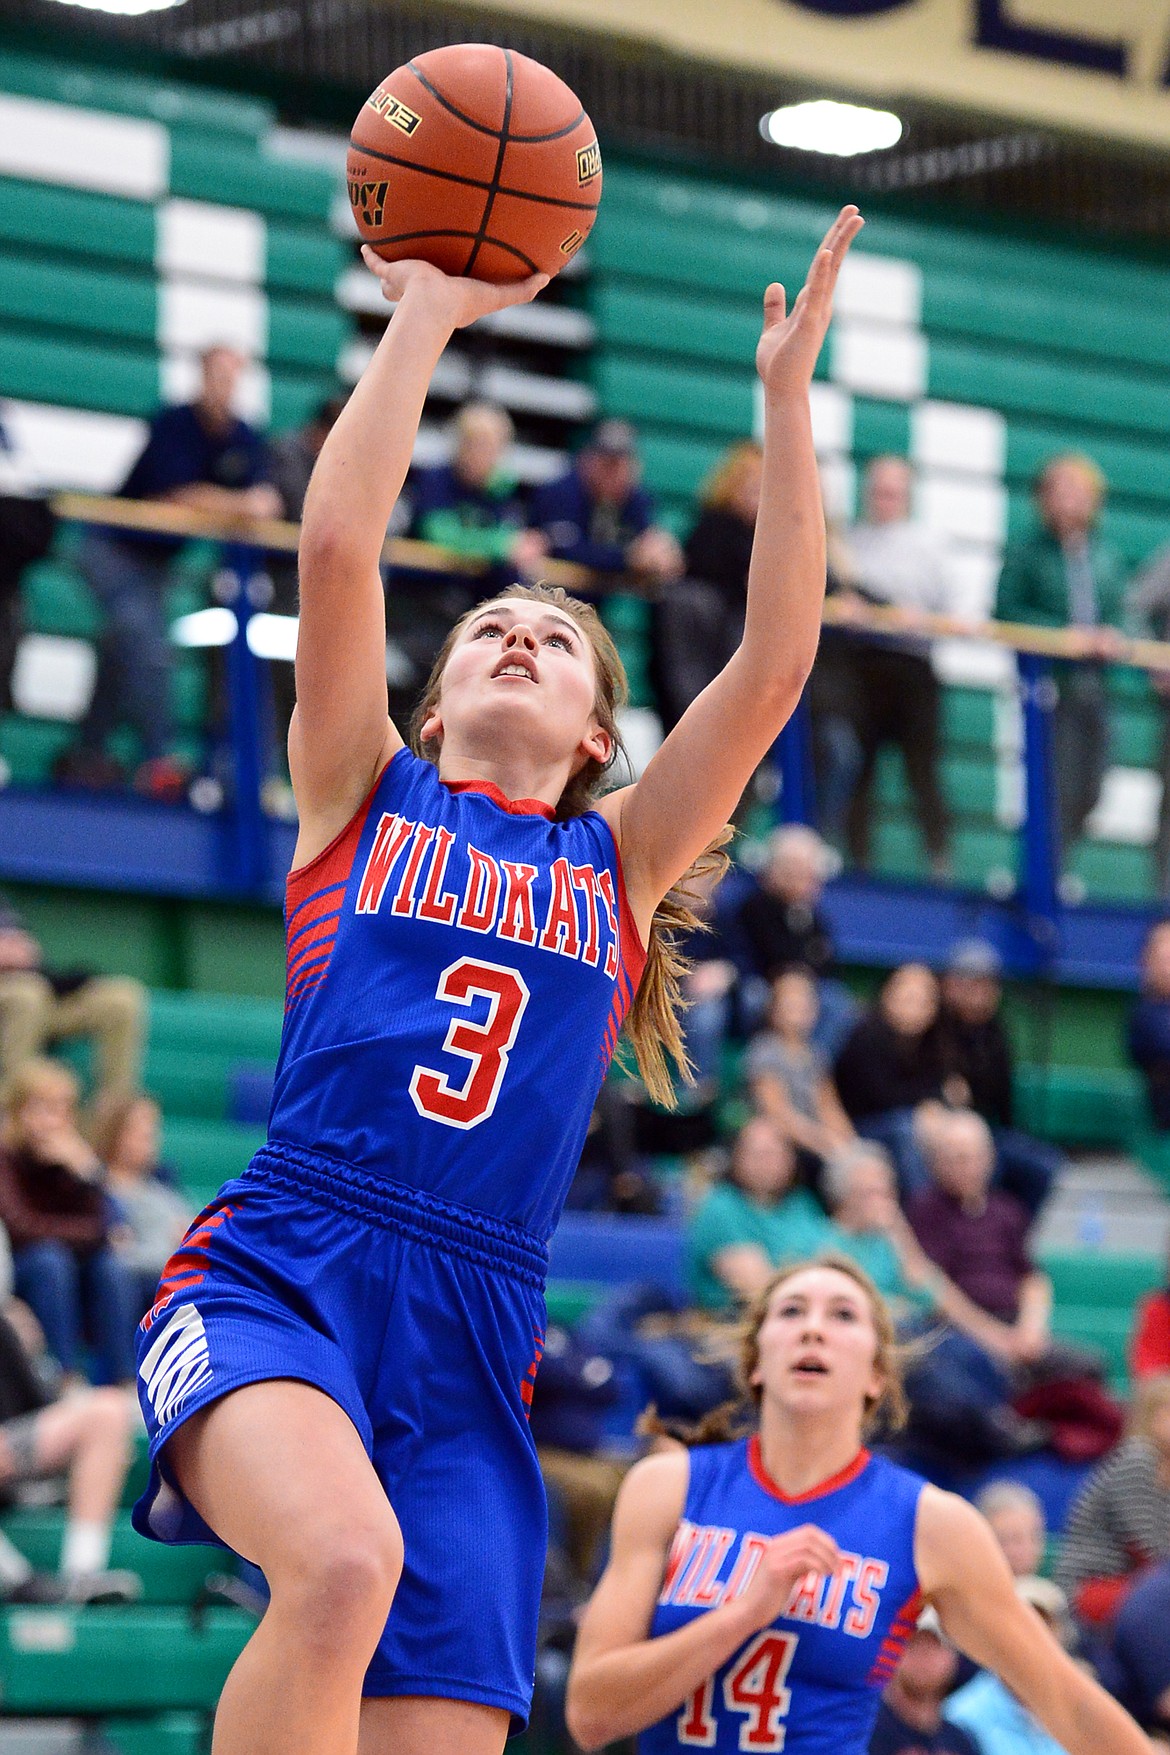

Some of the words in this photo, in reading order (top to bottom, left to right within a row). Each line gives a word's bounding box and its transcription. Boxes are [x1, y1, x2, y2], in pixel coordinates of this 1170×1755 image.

[354, 811, 619, 982] WILDKATS
[407, 955, 532, 1131] 3
[676, 1628, 799, 1754] 14
